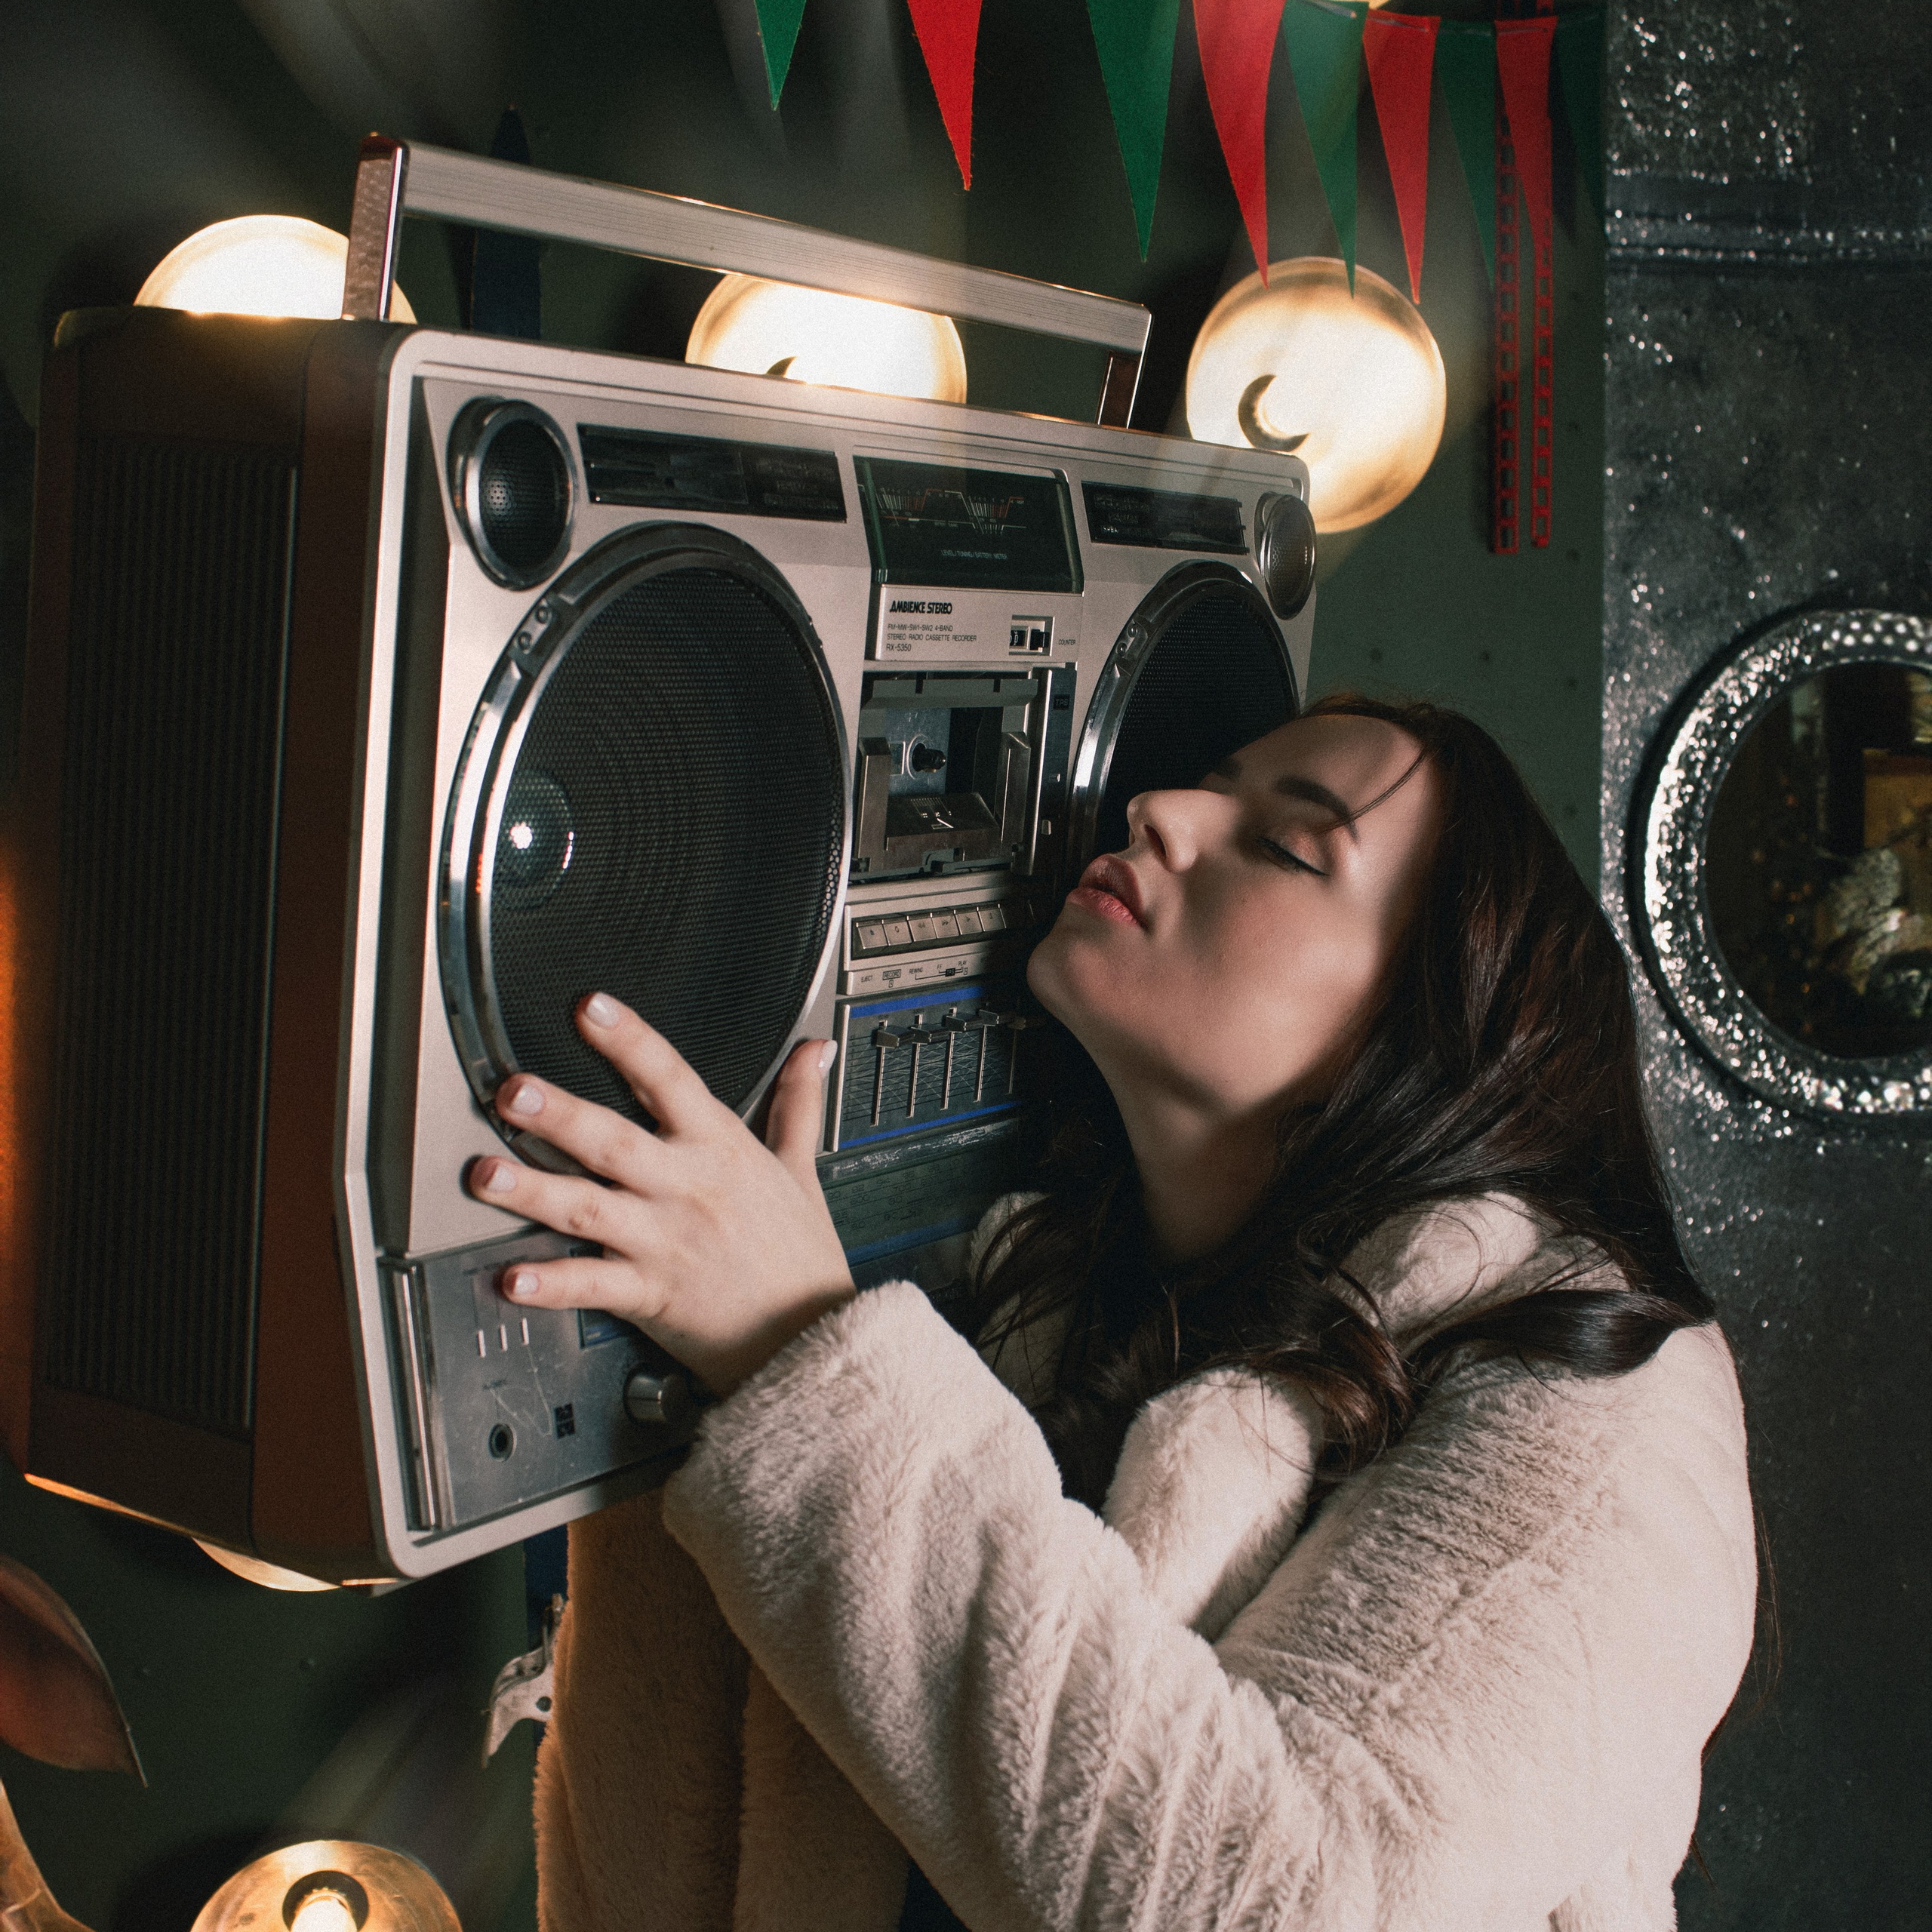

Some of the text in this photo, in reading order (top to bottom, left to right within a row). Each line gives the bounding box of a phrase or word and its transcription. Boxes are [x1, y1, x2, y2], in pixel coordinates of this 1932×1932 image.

[889, 600, 952, 614] AMBIENCE STEREO
[1056, 697, 1069, 706] TPS
[884, 971, 900, 979] RECORD
